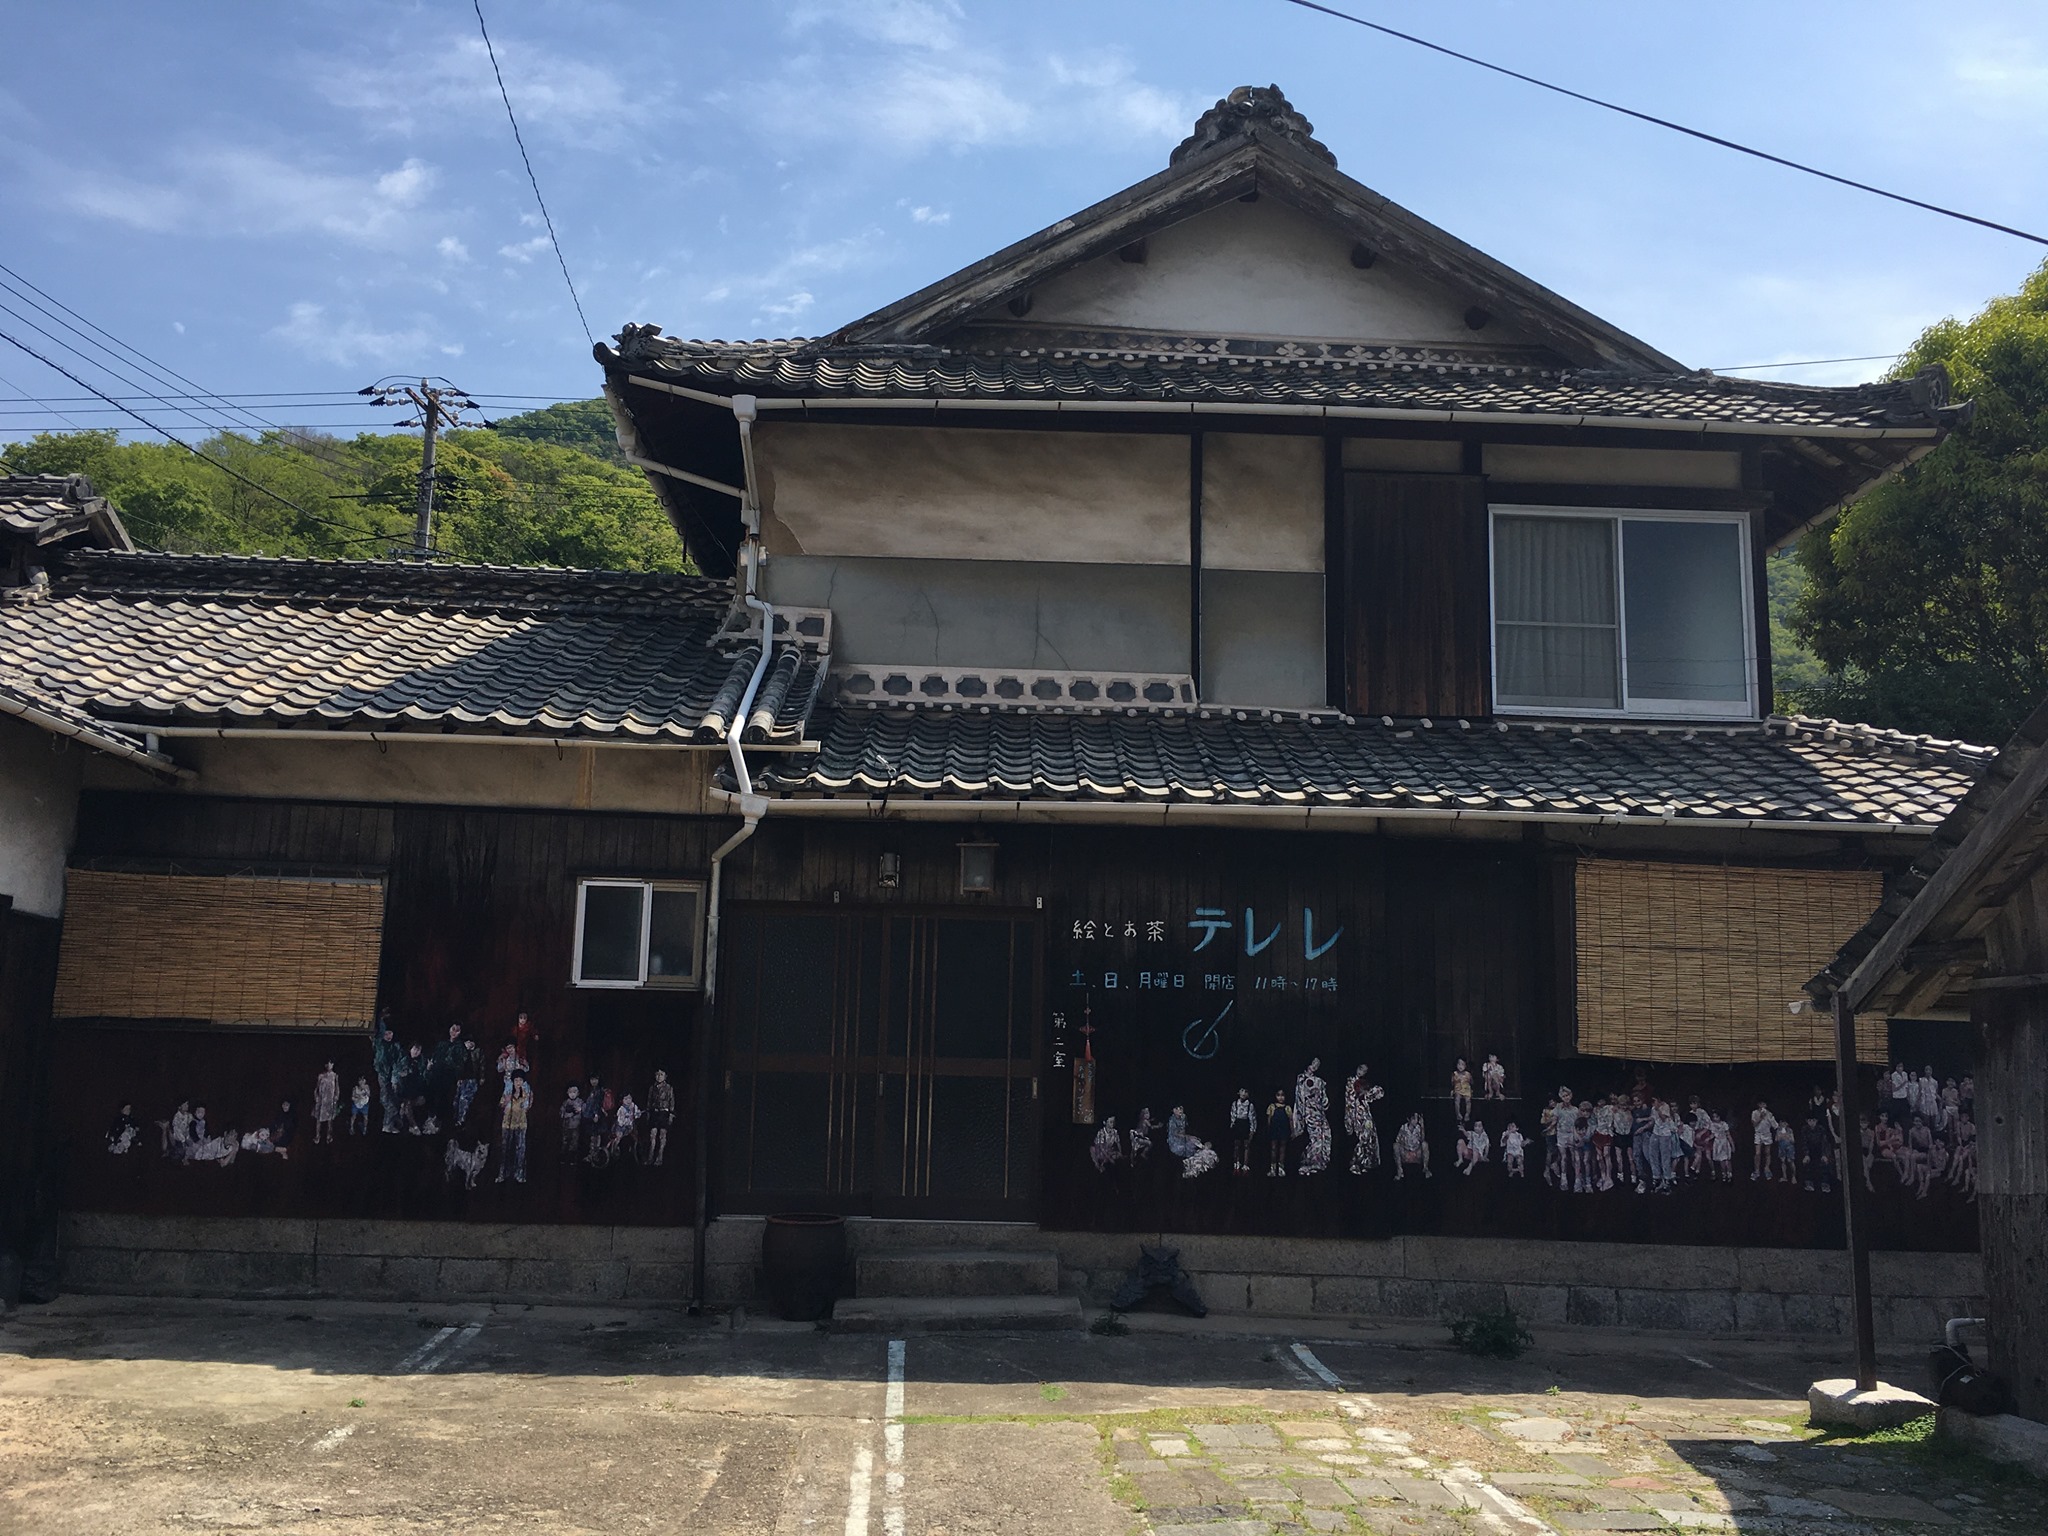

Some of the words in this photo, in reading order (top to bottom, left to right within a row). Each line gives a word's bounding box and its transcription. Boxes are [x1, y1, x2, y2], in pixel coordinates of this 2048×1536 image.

[1071, 918, 1166, 942] 絵とお茶
[1187, 907, 1344, 961] テレレ
[1204, 974, 1236, 991] 開店
[1052, 1012, 1067, 1068] 第二室
